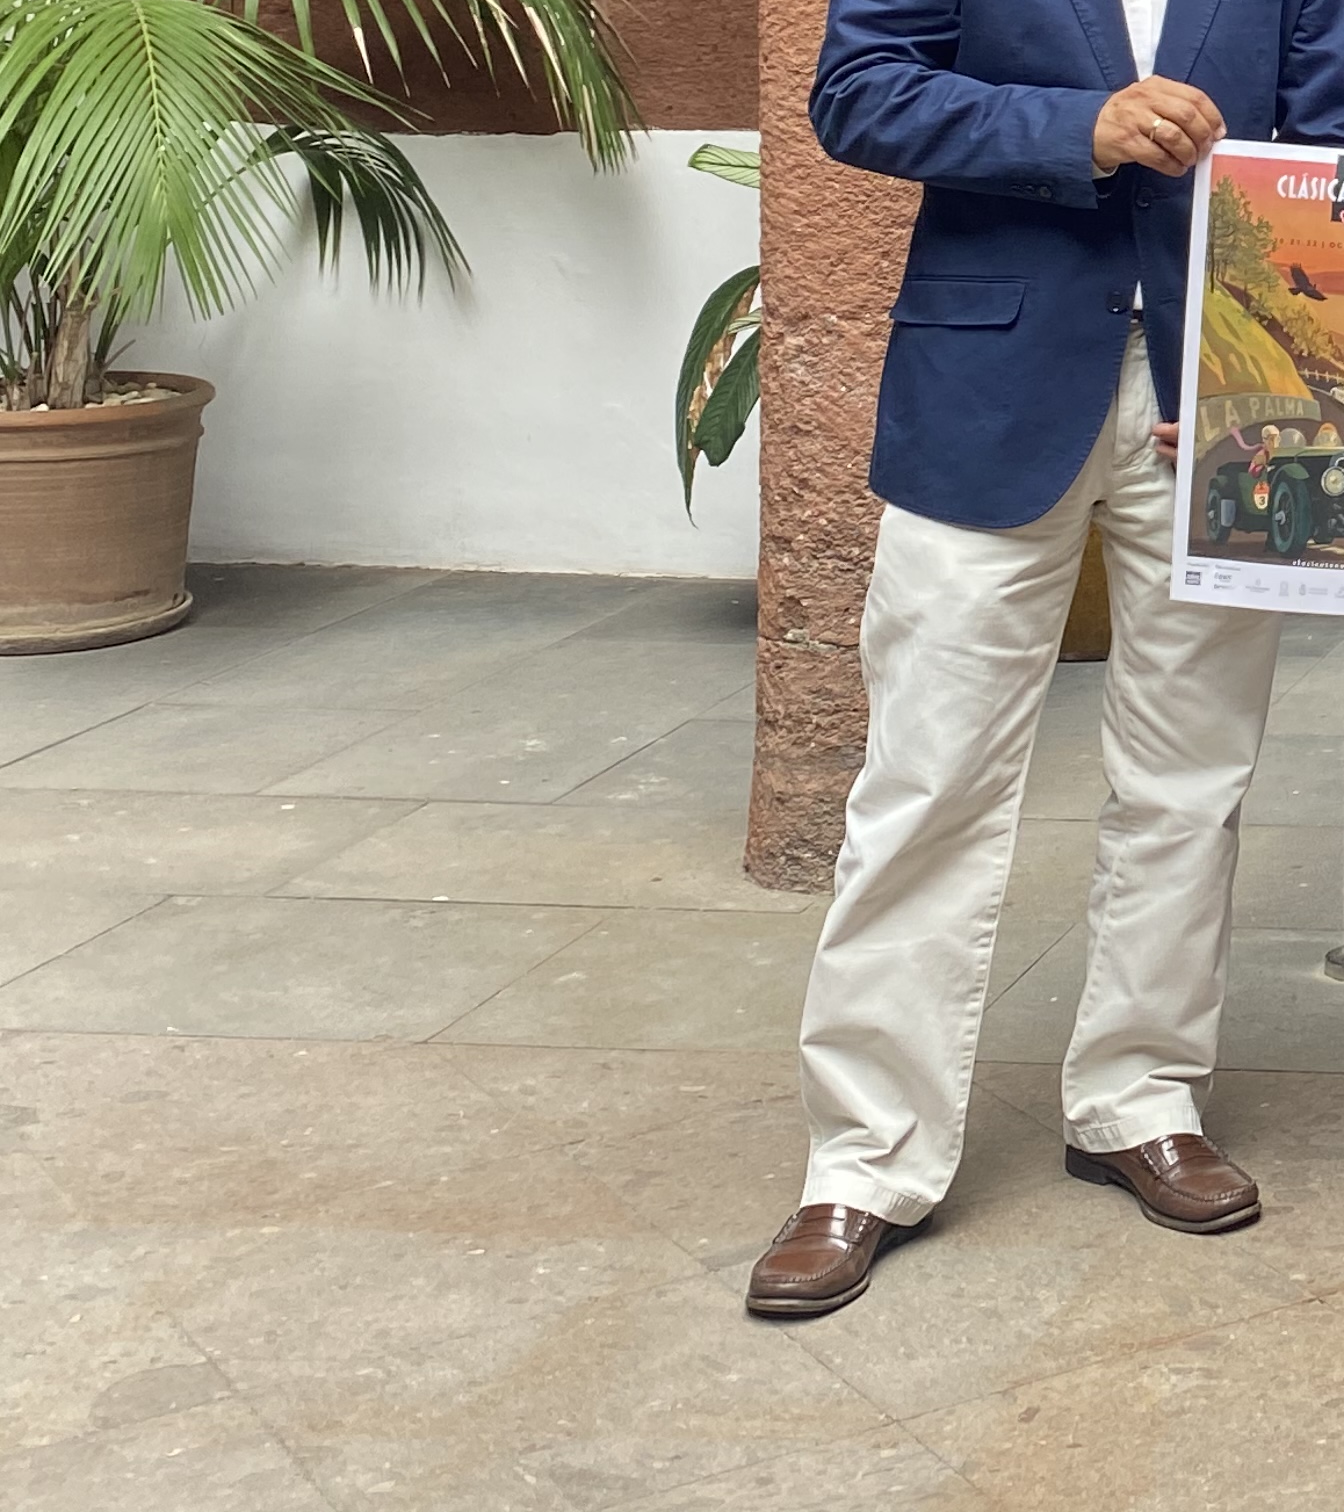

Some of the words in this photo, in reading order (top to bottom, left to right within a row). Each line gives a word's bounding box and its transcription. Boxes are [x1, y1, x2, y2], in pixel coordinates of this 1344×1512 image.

[1200, 399, 1241, 441] LA
[1249, 396, 1304, 419] PALMA
[1259, 496, 1266, 506] 3
